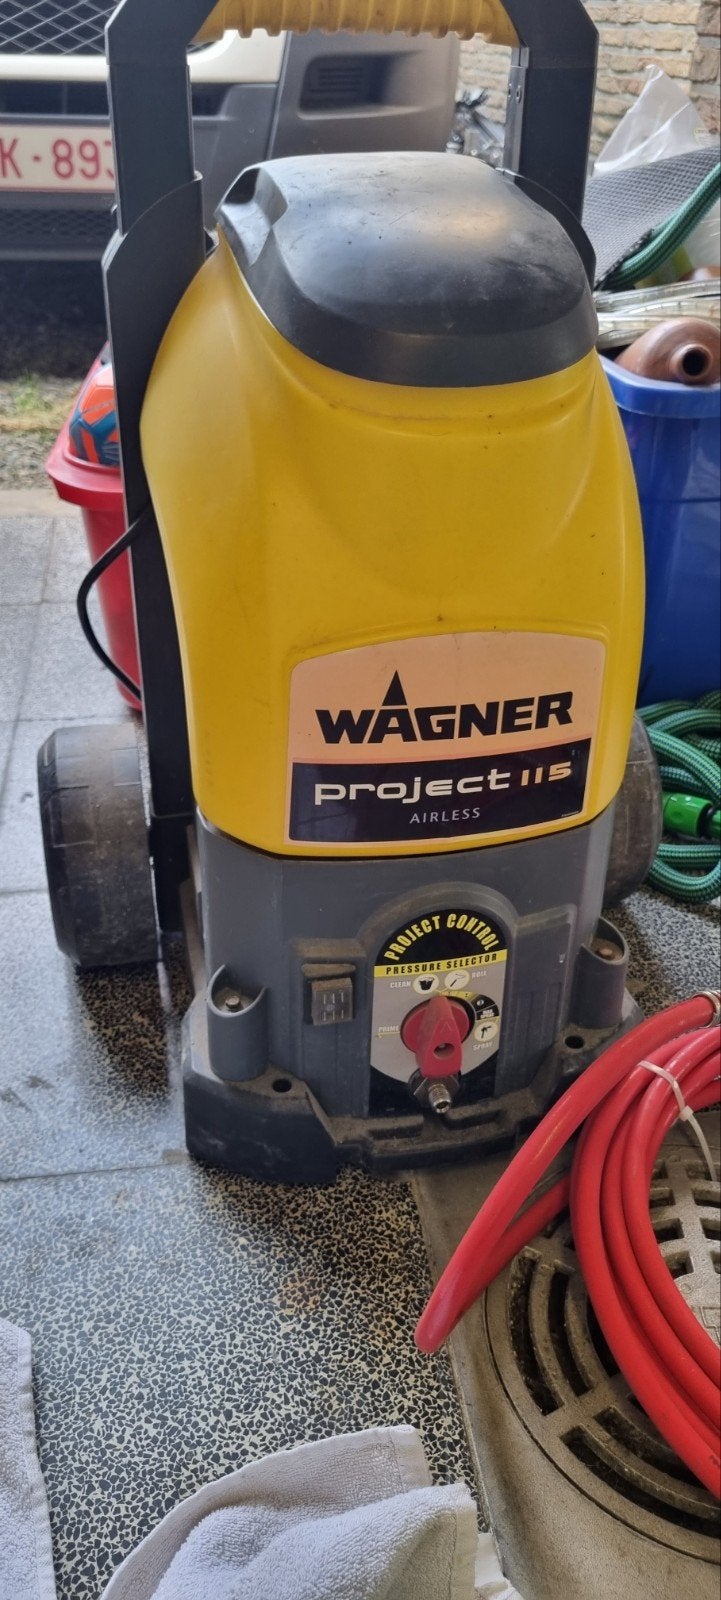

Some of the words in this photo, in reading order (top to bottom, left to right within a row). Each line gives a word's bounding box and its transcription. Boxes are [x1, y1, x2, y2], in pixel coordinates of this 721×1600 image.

[315, 670, 573, 744] WAGNER
[314, 768, 510, 805] project
[521, 761, 572, 786] 115
[409, 807, 480, 824] AIRLESS
[384, 915, 441, 961] PROJECT
[446, 913, 500, 951] CONTROL
[386, 962, 441, 975] PRESSURE
[446, 953, 497, 969] SELECTOR
[389, 980, 412, 989] CLEAN
[378, 1025, 399, 1033] PRIME
